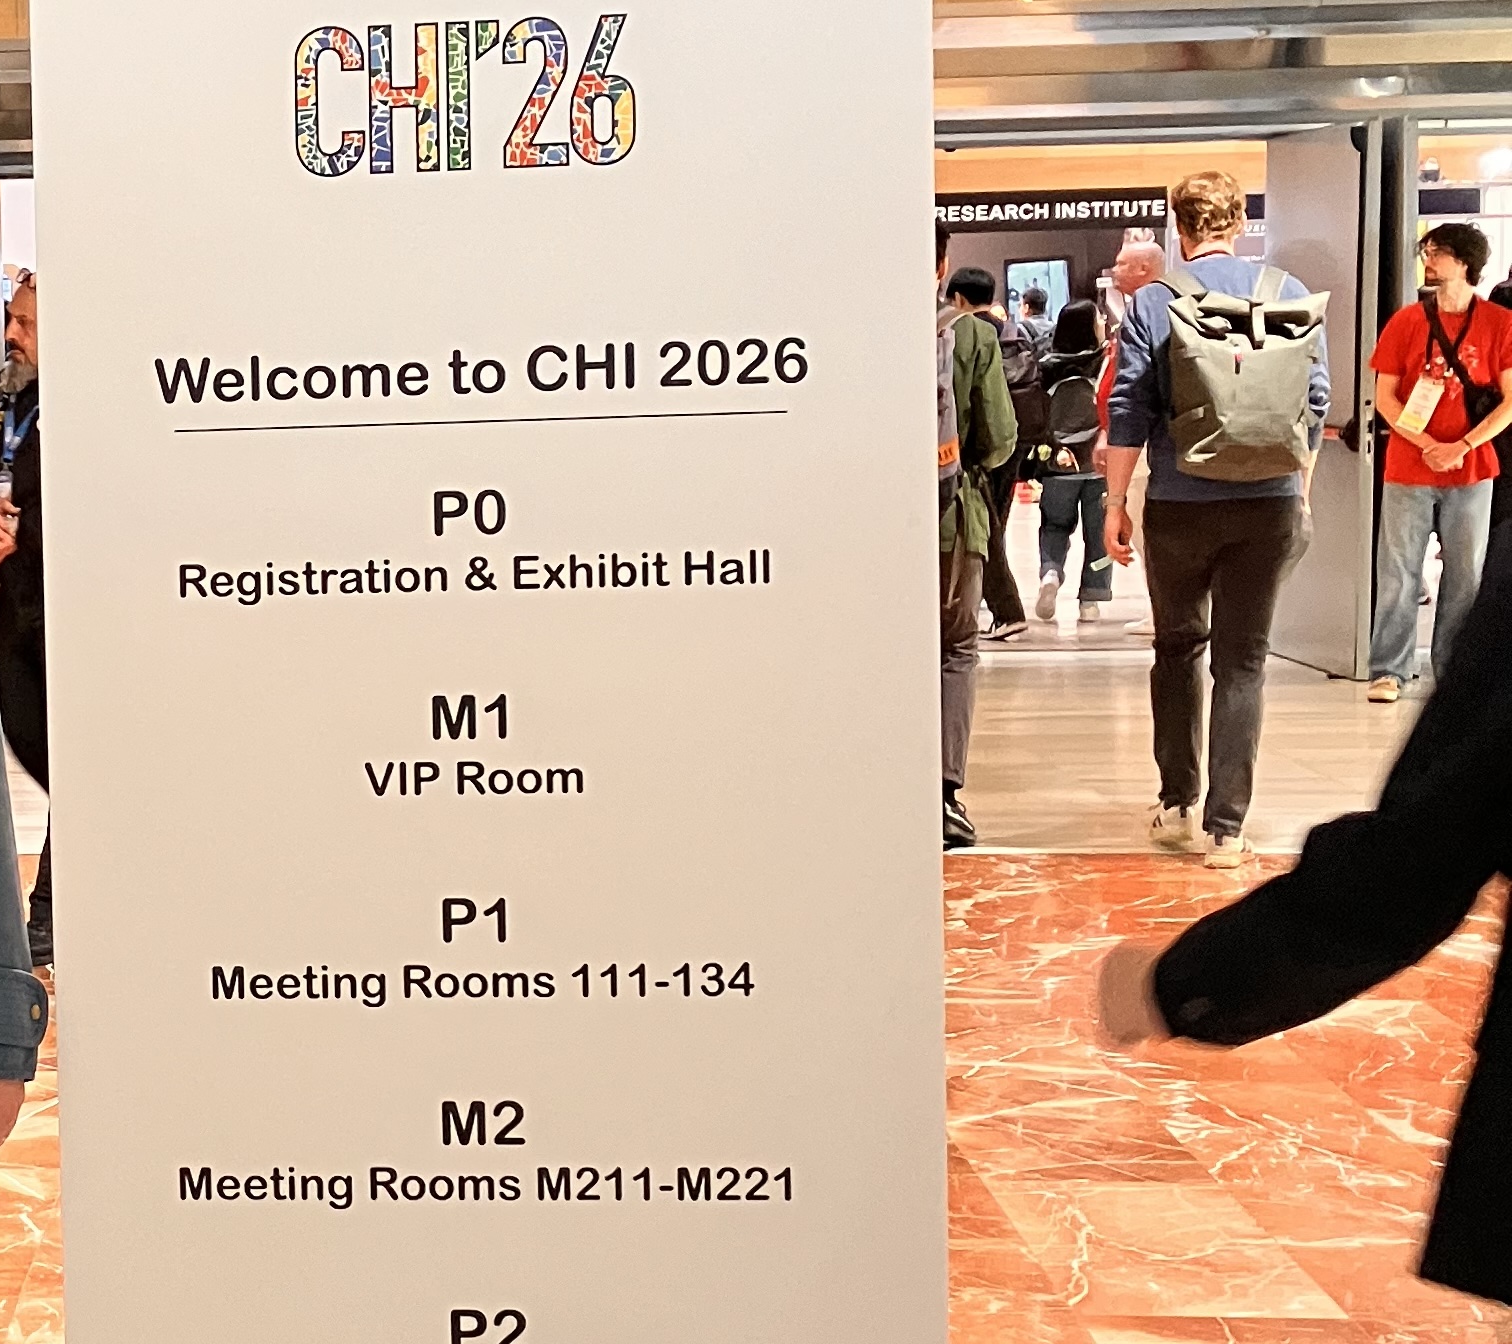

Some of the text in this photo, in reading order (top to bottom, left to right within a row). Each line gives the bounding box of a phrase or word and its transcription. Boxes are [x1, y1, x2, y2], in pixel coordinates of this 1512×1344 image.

[293, 12, 637, 178] CHI'26
[935, 199, 1166, 223] RESEARCH INSTITUTE
[154, 337, 808, 404] Welcome to CHI 2026
[433, 489, 506, 537] P0
[179, 548, 770, 606] Registration & Exhibit Hall
[431, 693, 507, 741] M1
[364, 761, 584, 797] VIP Room
[442, 897, 507, 944] P1
[212, 961, 755, 1008] Meeting Rooms 111-134
[441, 1100, 526, 1146] M2
[179, 1166, 792, 1210] Meeting Rooms M211-M221
